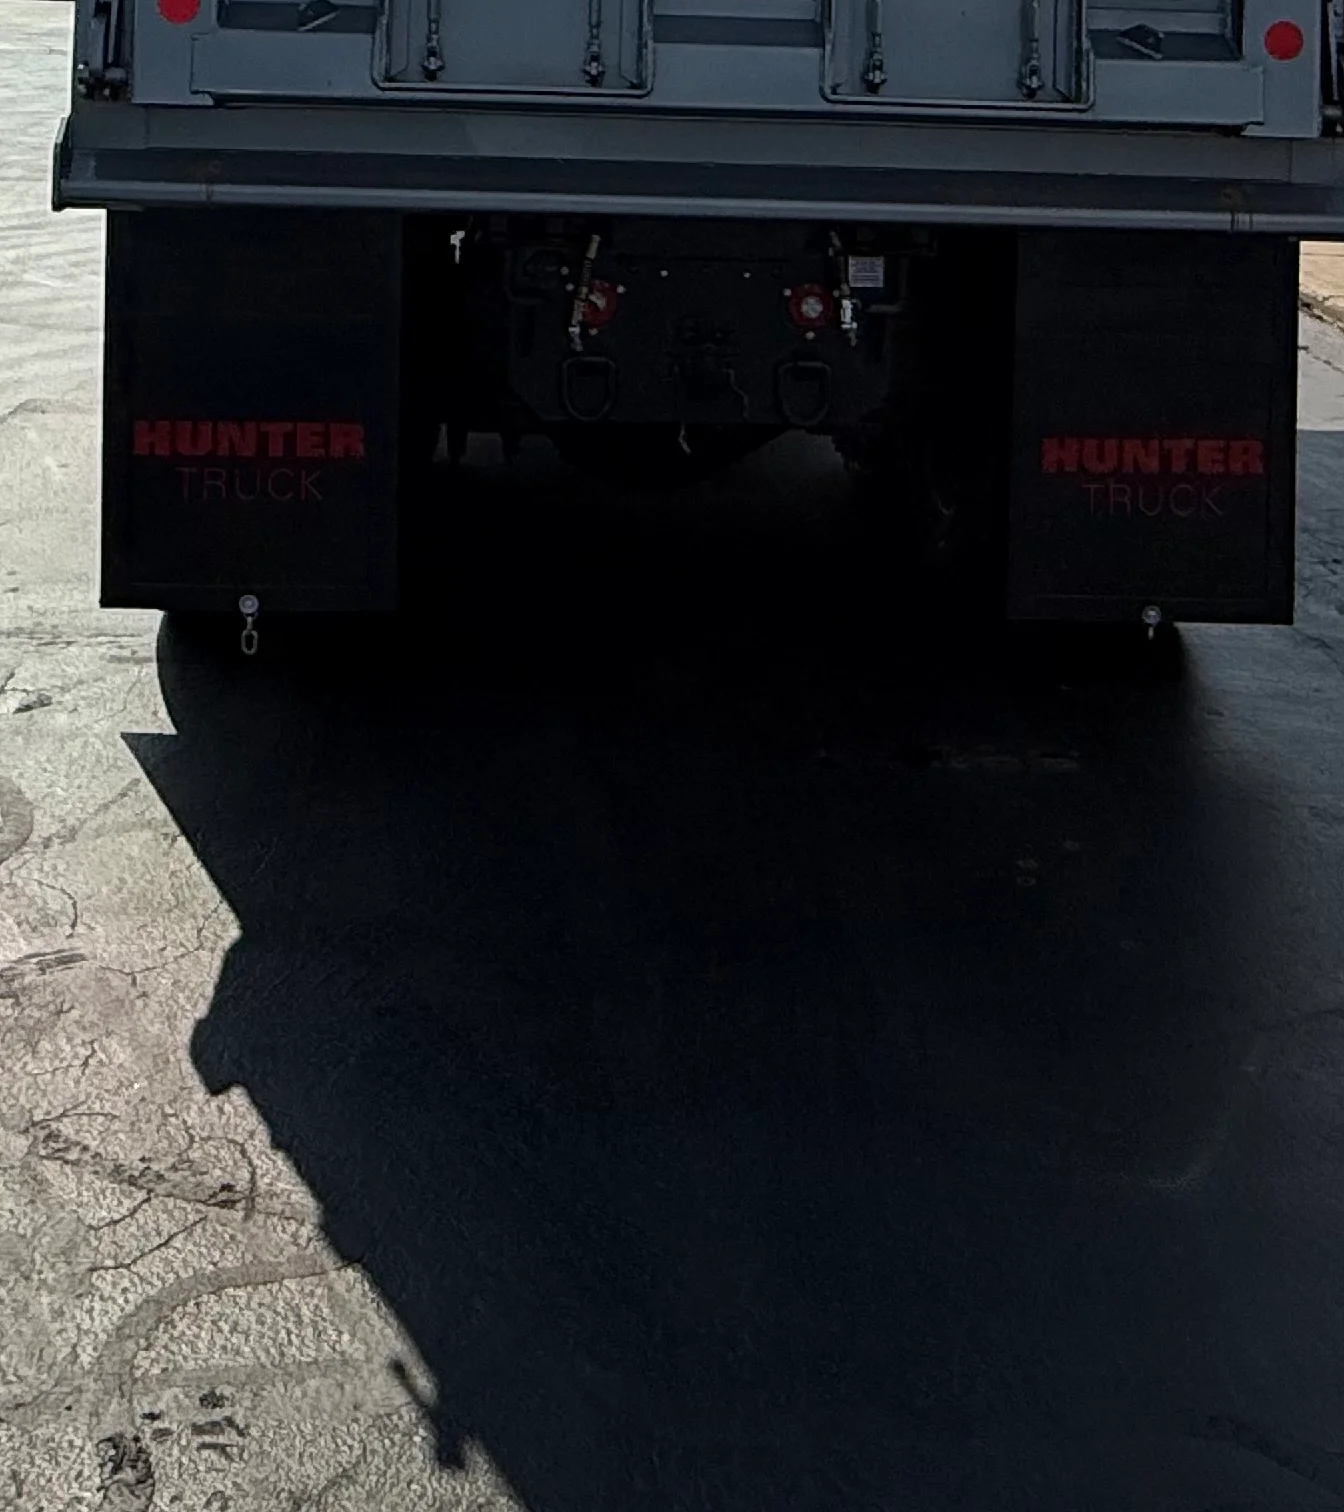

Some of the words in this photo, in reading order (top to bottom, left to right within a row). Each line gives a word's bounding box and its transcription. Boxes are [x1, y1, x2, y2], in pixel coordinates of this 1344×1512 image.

[133, 420, 366, 458] HUNTER
[1040, 438, 1265, 474] HUNTER
[175, 467, 323, 502] TRUCK
[1082, 484, 1224, 518] TRUCK
